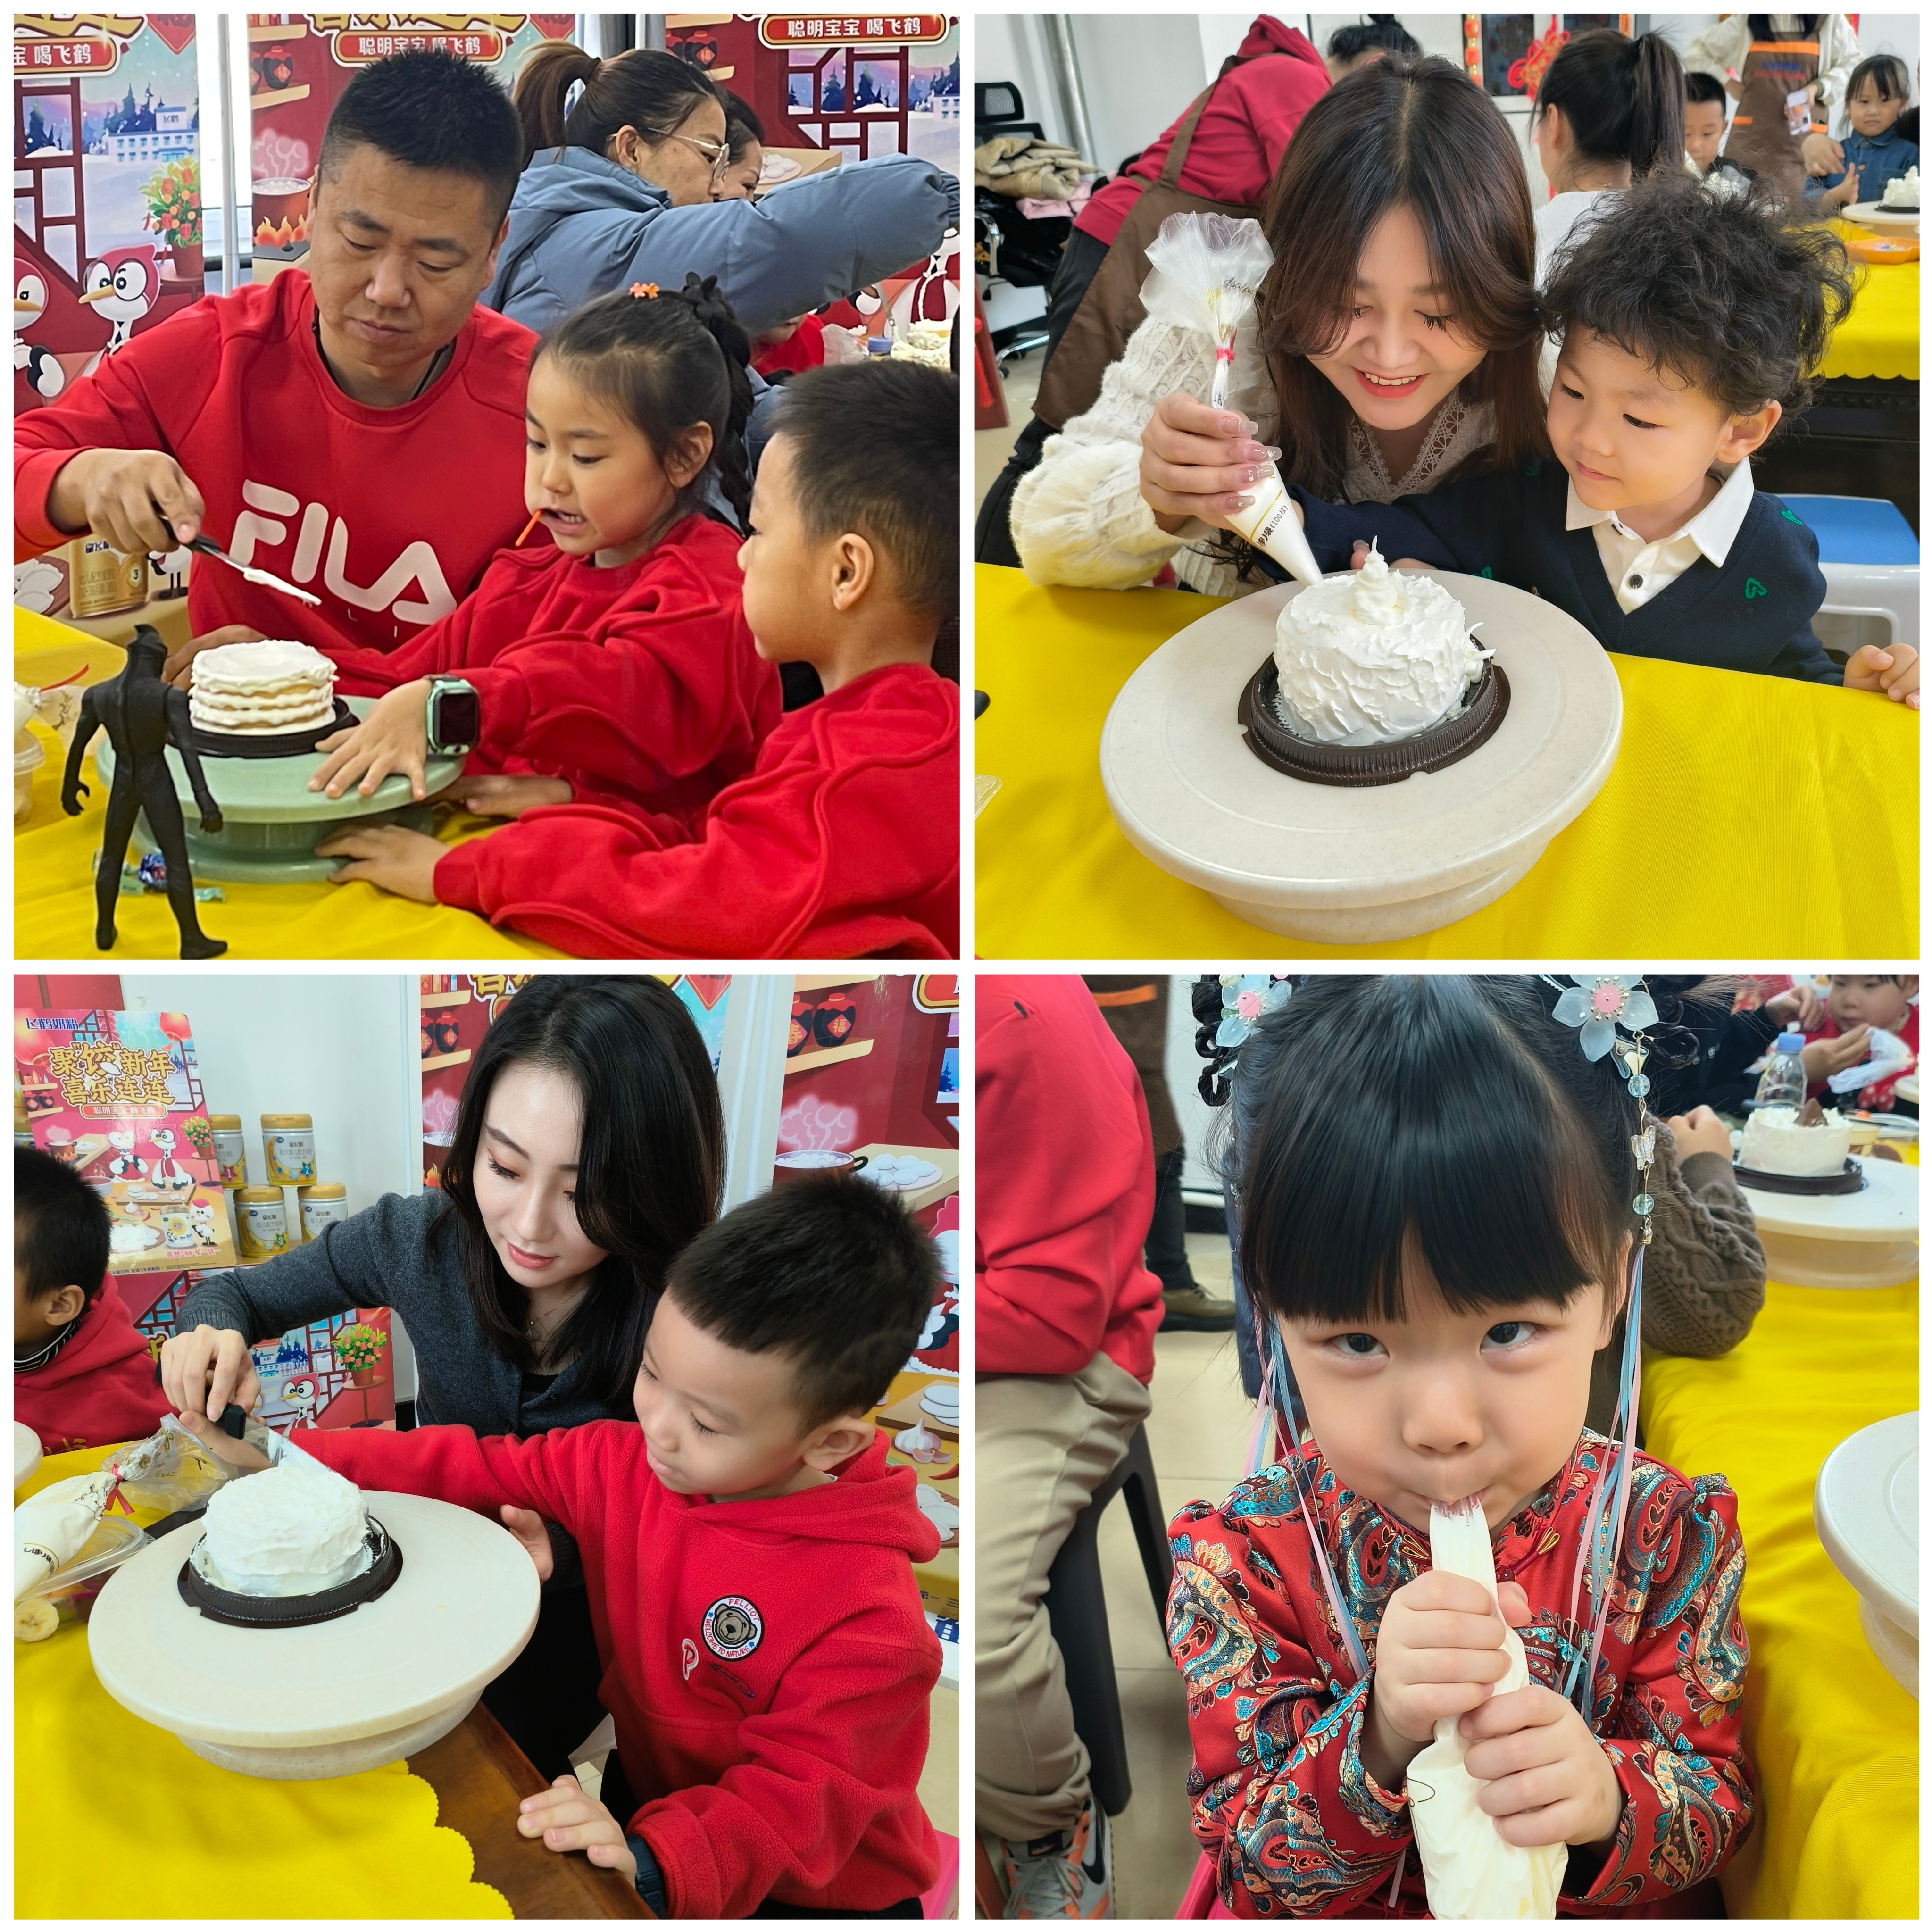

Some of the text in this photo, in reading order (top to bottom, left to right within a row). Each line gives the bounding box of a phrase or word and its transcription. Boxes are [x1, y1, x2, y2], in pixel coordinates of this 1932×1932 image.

[787, 17, 920, 37] 聪明宝宝 喝飞鹤
[34, 44, 91, 65] 喝飞鹤
[229, 479, 457, 625] FILA
[133, 569, 139, 580] 3
[25, 1018, 78, 1030] 飞鹤奶粉
[833, 1019, 846, 1033] 福
[447, 1032, 455, 1042] 福
[64, 1076, 176, 1105] 喜乐连连
[93, 1106, 127, 1115] 聪明宝宝
[227, 1168, 232, 1178] 1
[305, 1165, 310, 1174] 2
[278, 1237, 283, 1245] 3
[728, 1599, 760, 1622] PELLIOT
[705, 1619, 719, 1650] WELCOME
[717, 1646, 726, 1655] TO
[683, 1643, 696, 1675] P
